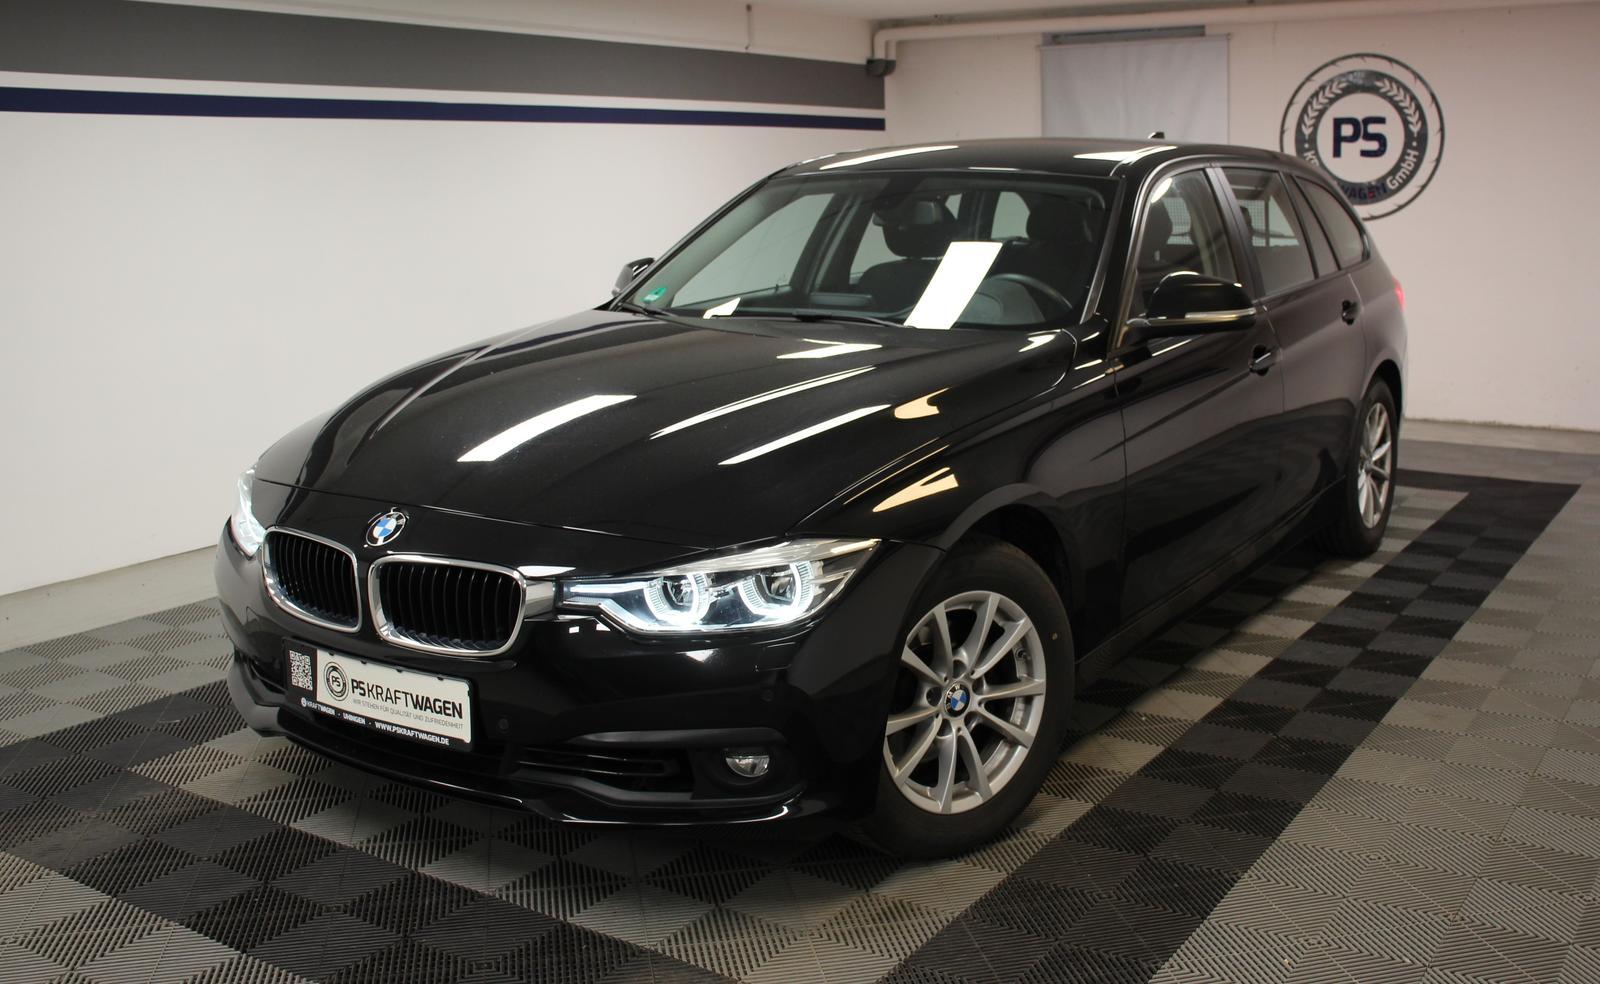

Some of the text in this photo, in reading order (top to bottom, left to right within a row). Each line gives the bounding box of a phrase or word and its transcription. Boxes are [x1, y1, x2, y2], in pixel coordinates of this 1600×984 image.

[1333, 116, 1388, 158] PS
[1386, 149, 1420, 190] GmbH
[331, 675, 341, 687] PS
[375, 721, 450, 746] WWW.PSKRAFTWAGEN.DE
